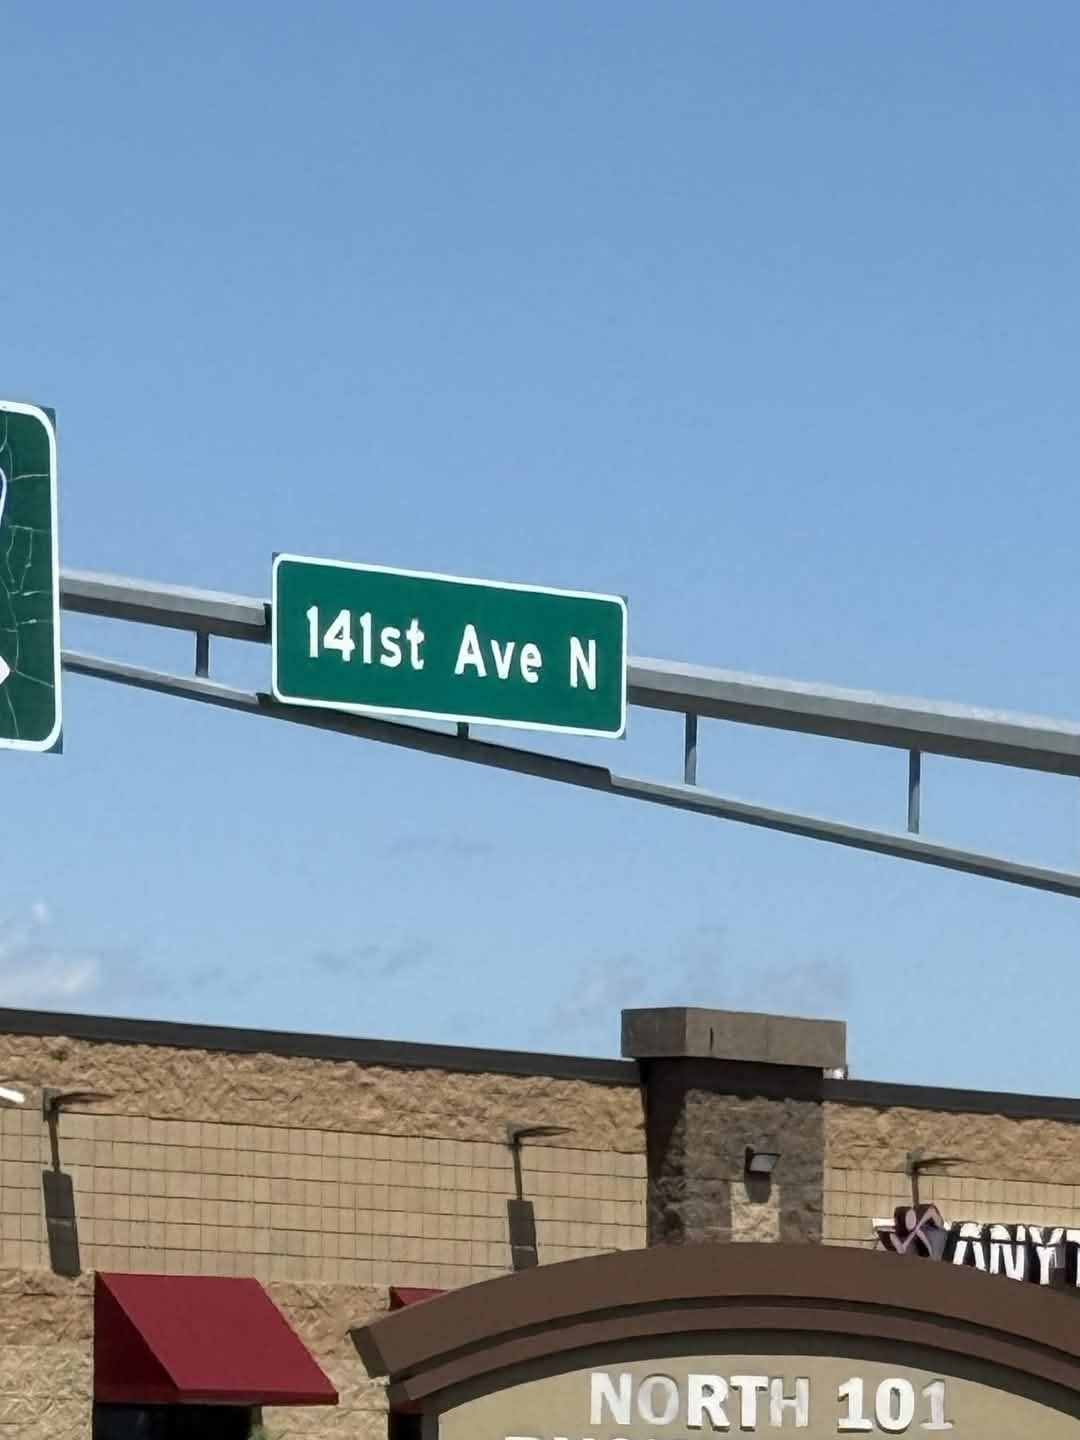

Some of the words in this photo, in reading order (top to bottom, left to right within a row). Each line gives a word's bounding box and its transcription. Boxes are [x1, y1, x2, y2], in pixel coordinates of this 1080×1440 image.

[305, 604, 426, 671] 141st
[454, 623, 544, 684] Ave
[568, 636, 598, 692] N
[590, 1372, 809, 1431] NORTH
[836, 1376, 954, 1433] 101
